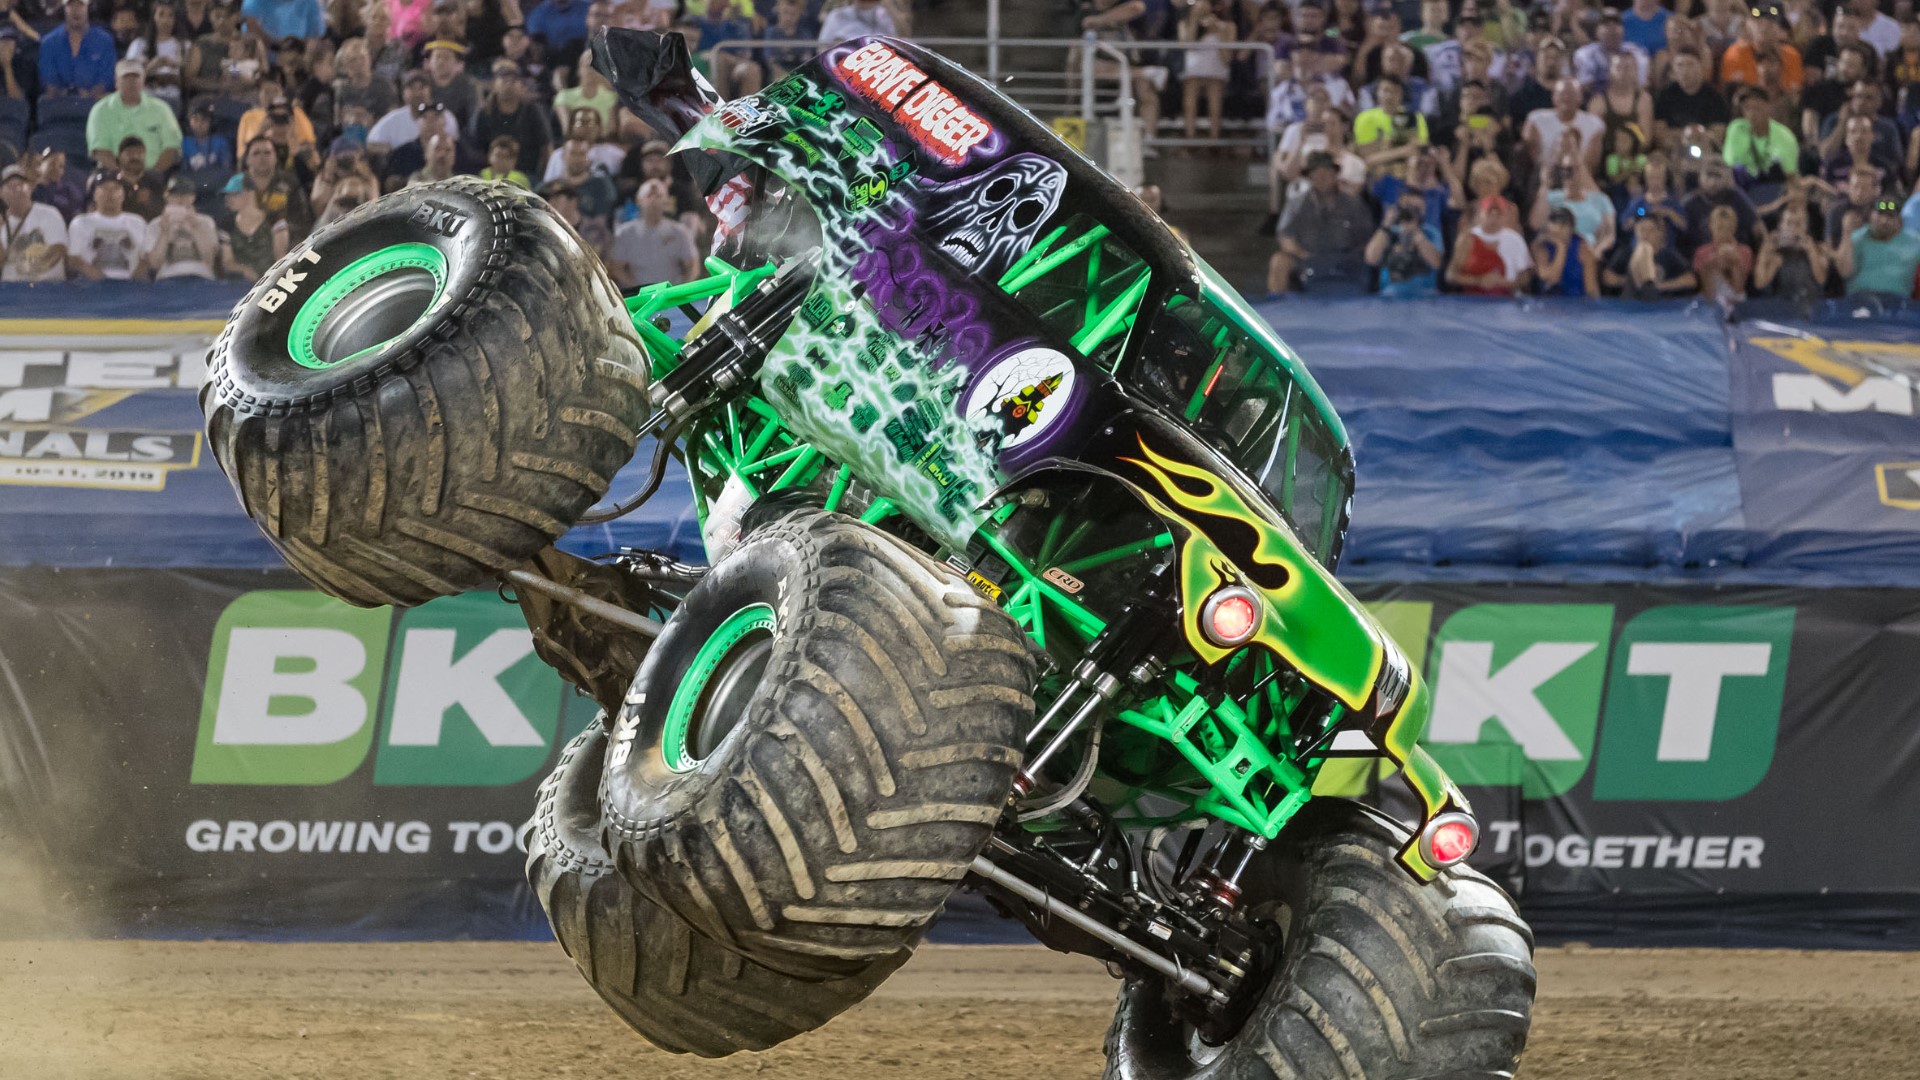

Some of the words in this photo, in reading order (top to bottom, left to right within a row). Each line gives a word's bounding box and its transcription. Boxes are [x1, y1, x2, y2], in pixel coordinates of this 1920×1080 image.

[843, 41, 928, 105] GRAVE
[903, 82, 989, 156] DIGGER
[412, 202, 468, 233] BKT
[257, 247, 321, 313] BKT
[610, 687, 646, 769] BKT
[1330, 641, 1772, 761] KT
[185, 820, 431, 853] GROWING
